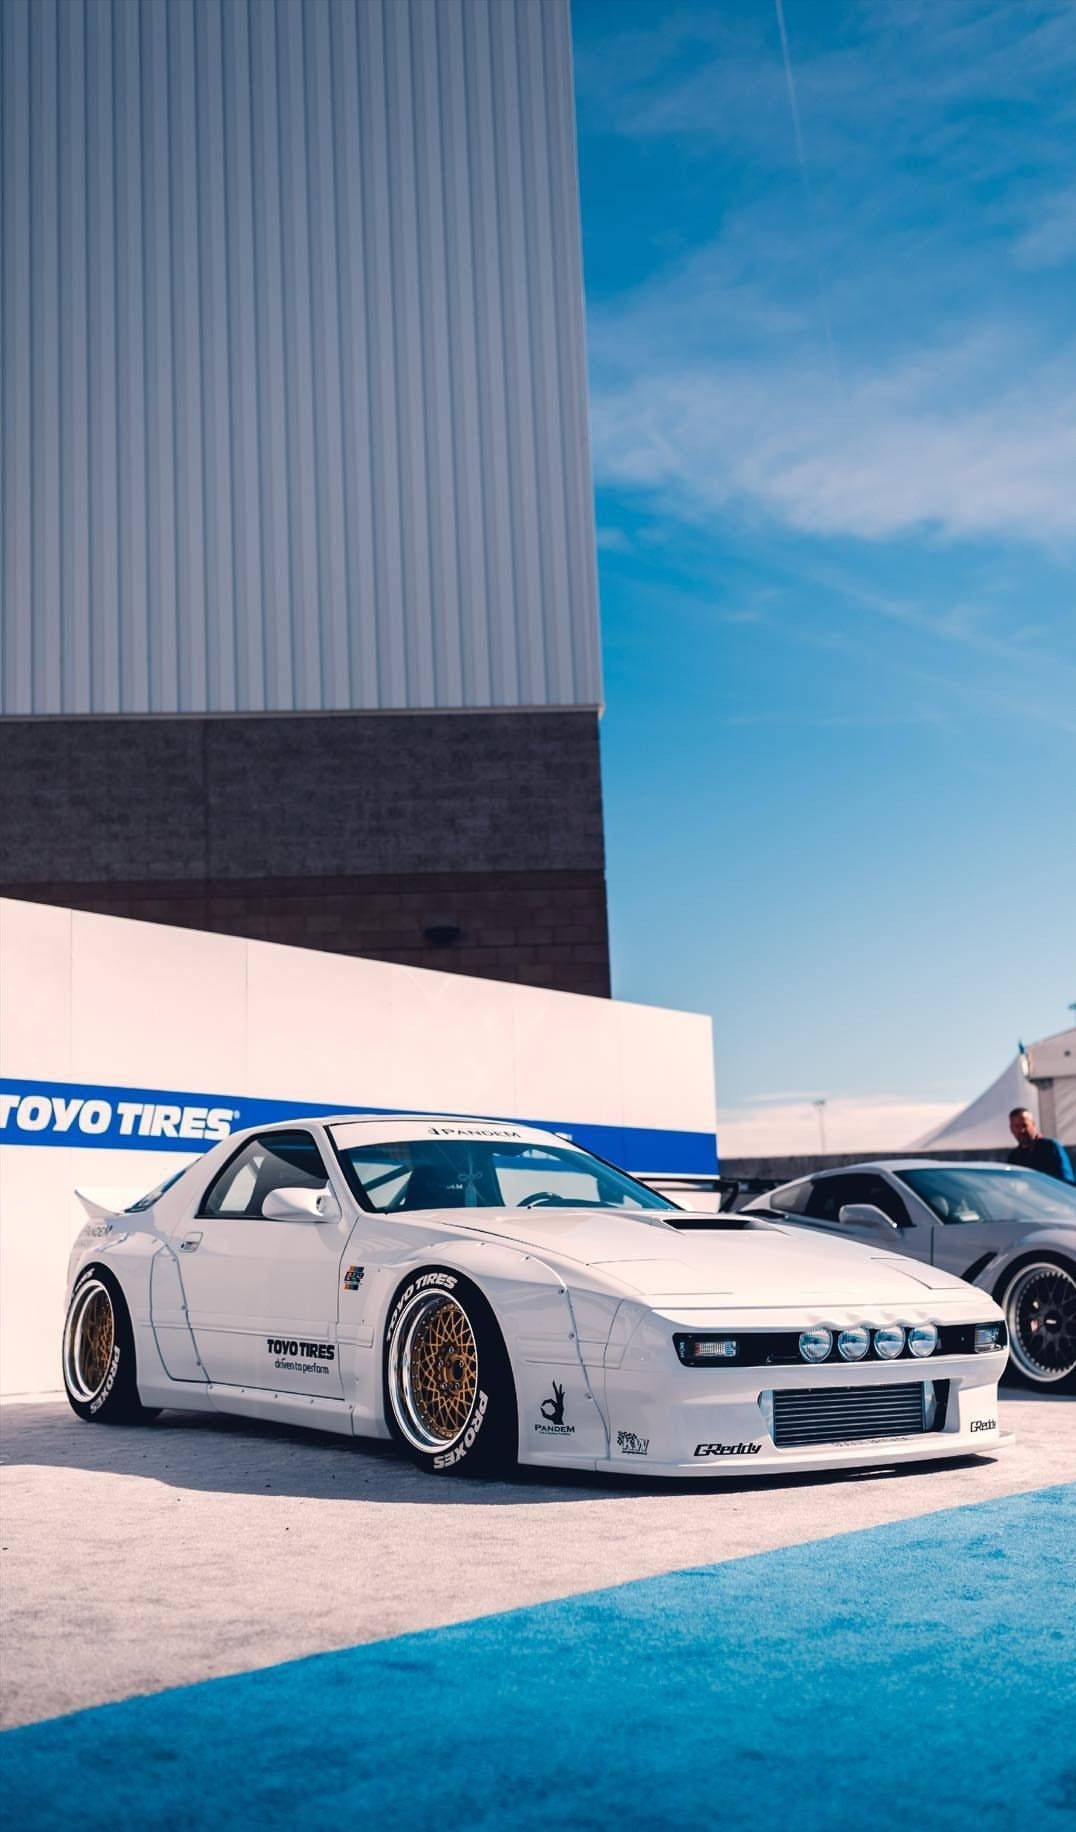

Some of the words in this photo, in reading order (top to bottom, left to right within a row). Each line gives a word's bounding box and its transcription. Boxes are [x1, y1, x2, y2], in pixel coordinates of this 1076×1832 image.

[0, 1094, 111, 1134] TOYO
[415, 1273, 458, 1290] TIRES
[266, 1339, 298, 1356] TOYO
[299, 1342, 335, 1360] TIRES
[274, 1358, 295, 1370] driven
[433, 1389, 489, 1469] PROXES
[534, 1424, 575, 1433] PANDEM
[694, 1443, 762, 1456] GReddy
